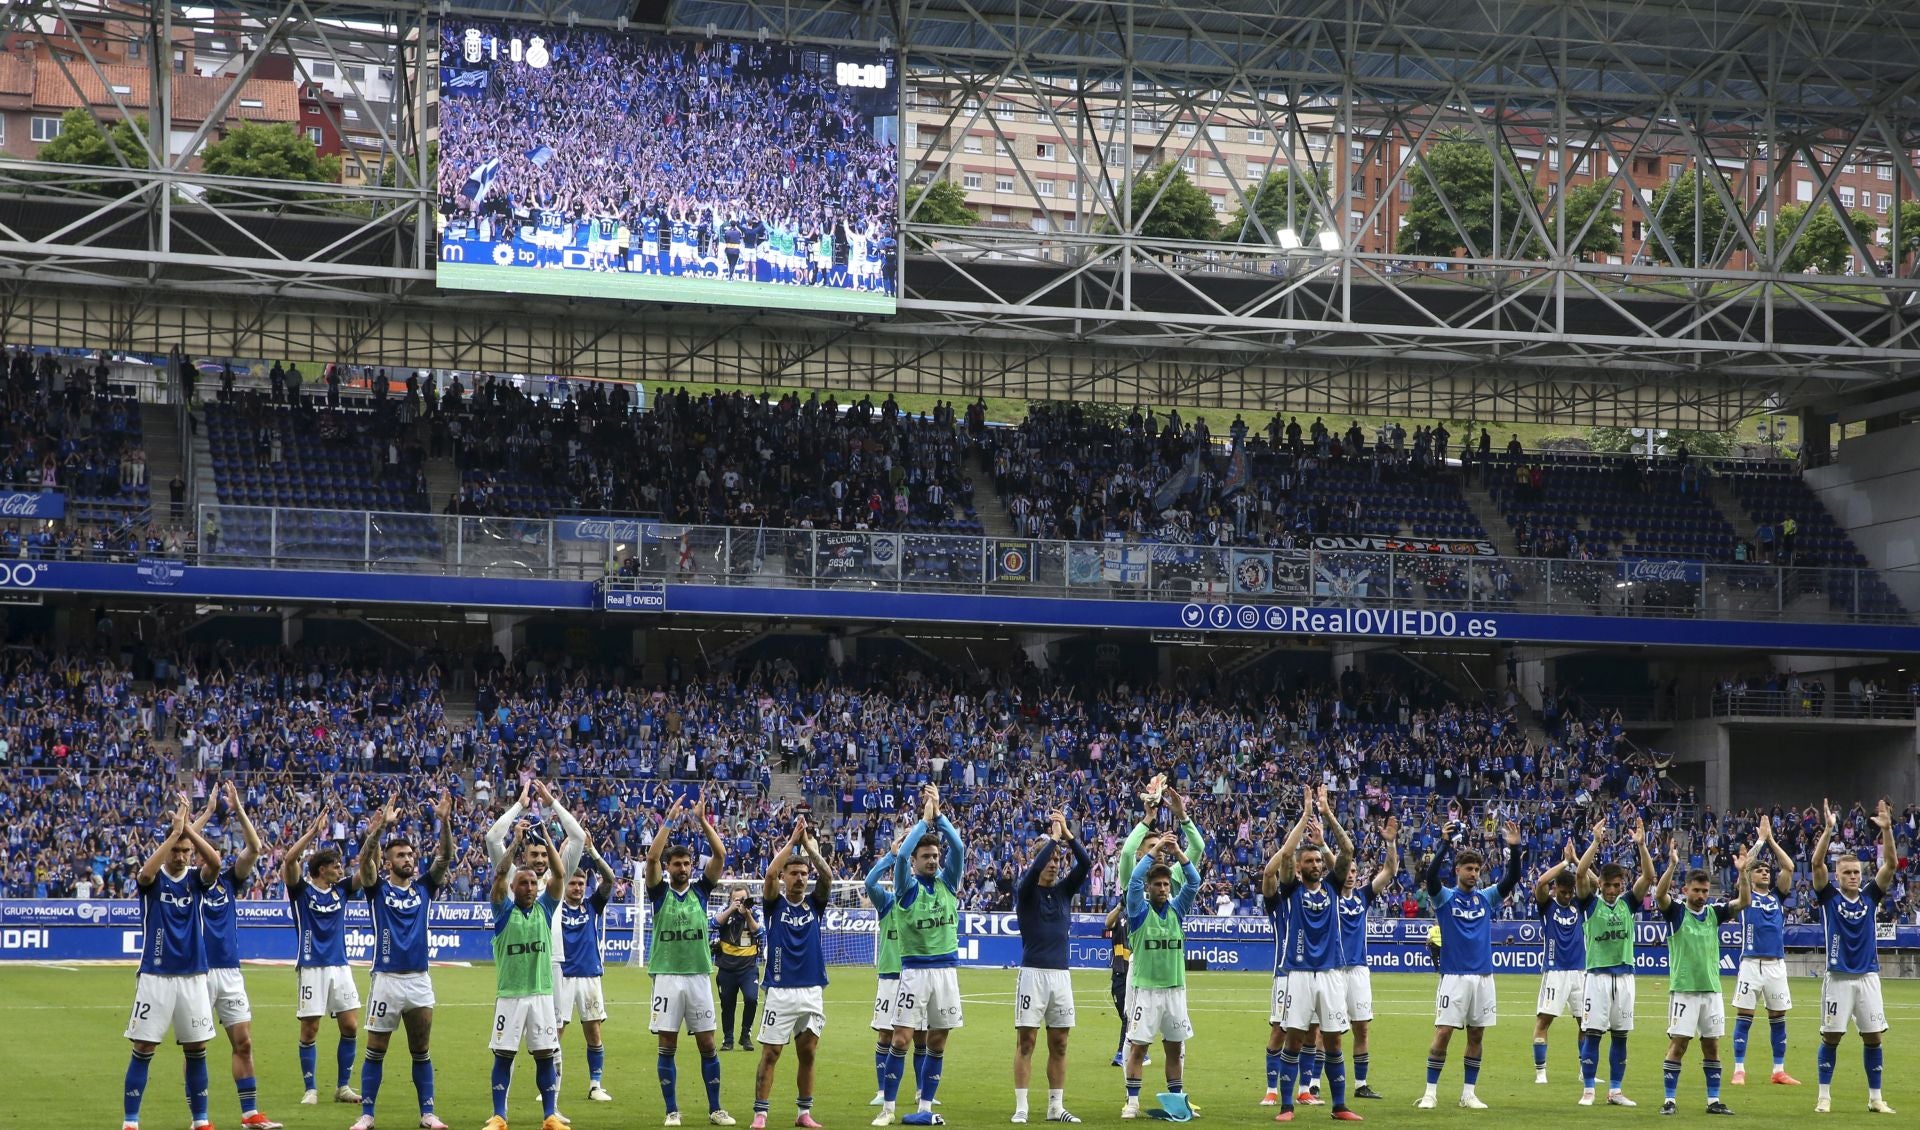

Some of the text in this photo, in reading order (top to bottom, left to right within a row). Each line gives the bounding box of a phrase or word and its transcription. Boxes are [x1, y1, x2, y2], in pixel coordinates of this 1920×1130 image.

[836, 62, 887, 88] 90:00
[518, 248, 535, 263] bp
[607, 595, 663, 606] Real OVIEDO
[1292, 606, 1497, 638] RealOVIEDO.es
[4, 906, 75, 916] GRUPO PACHUCA
[111, 907, 140, 916] GRUPO
[245, 908, 283, 917] PACHUCA
[348, 908, 370, 918] PACH
[436, 905, 469, 921] Nueva
[471, 904, 494, 923] Esp
[1452, 907, 1486, 919] DIGI
[826, 909, 880, 931] Cuen
[660, 929, 703, 942] DIGI
[1238, 923, 1273, 934] NUTRI
[1367, 925, 1394, 935] RCIO
[1405, 924, 1419, 934] EL
[344, 929, 375, 947] aho
[1145, 939, 1182, 950] DIGI
[507, 940, 545, 956] DIGI
[1069, 943, 1112, 961] Funer
[1366, 951, 1399, 967] enda
[301, 986, 312, 1000] 15
[1546, 987, 1555, 1001] 11
[1738, 980, 1749, 995] 13
[653, 996, 668, 1013] 21
[874, 998, 890, 1014] 24
[897, 992, 915, 1009] 25
[1020, 994, 1031, 1010] 18
[1439, 995, 1449, 1009] 10
[1584, 998, 1591, 1012] 5
[135, 1001, 151, 1020] 12
[371, 1000, 387, 1018] 19
[1134, 1006, 1143, 1021] 6
[1673, 1002, 1686, 1018] 17
[1826, 1001, 1837, 1016] 14
[496, 1014, 506, 1031] 8
[763, 1009, 777, 1026] 16
